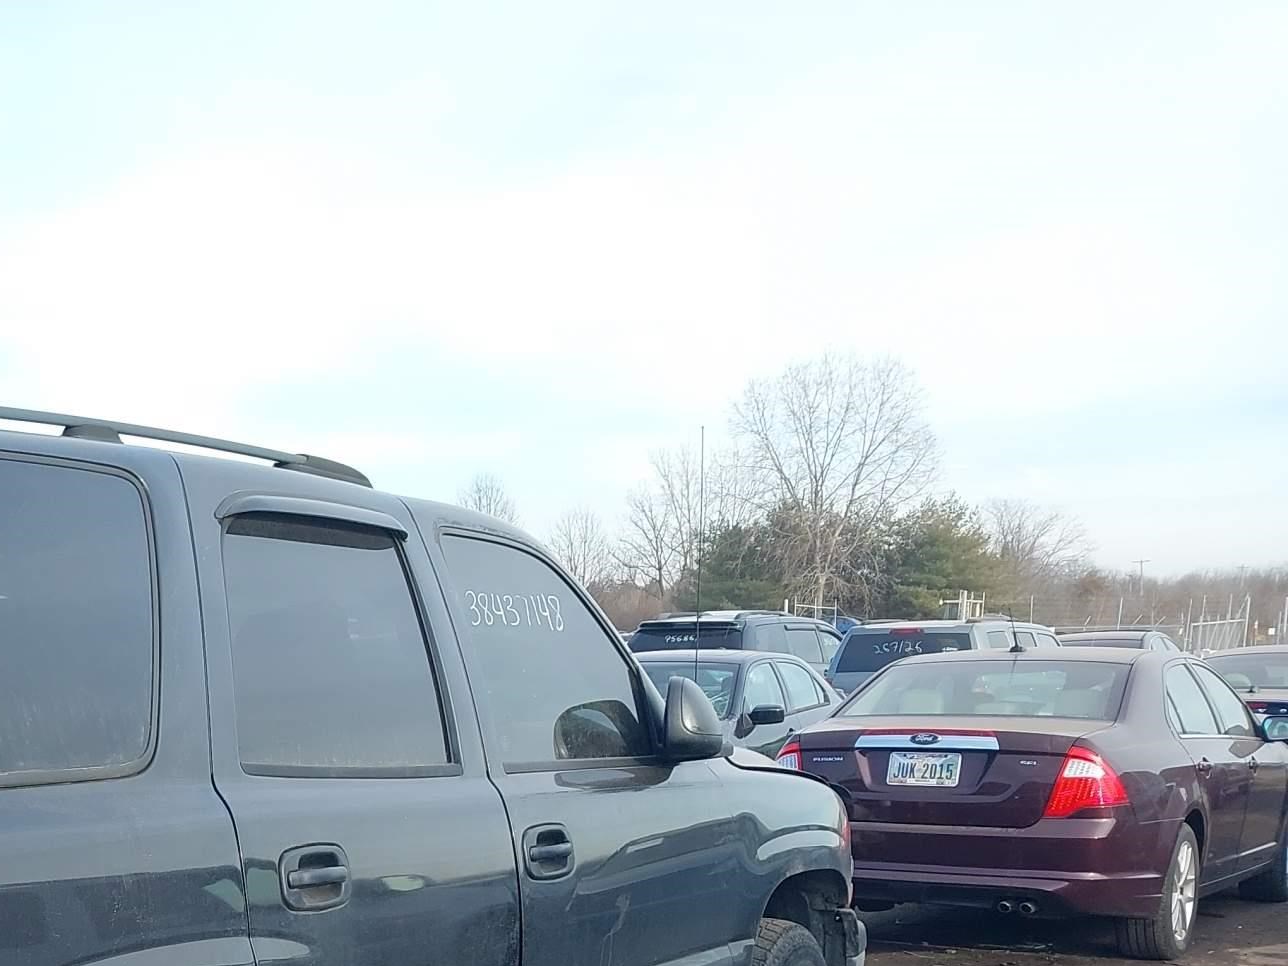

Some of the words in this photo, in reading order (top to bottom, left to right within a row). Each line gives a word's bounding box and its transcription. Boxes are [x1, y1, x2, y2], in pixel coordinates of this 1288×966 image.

[465, 590, 564, 631] 38437148
[893, 762, 917, 779] JUK
[921, 763, 954, 780] 2015
